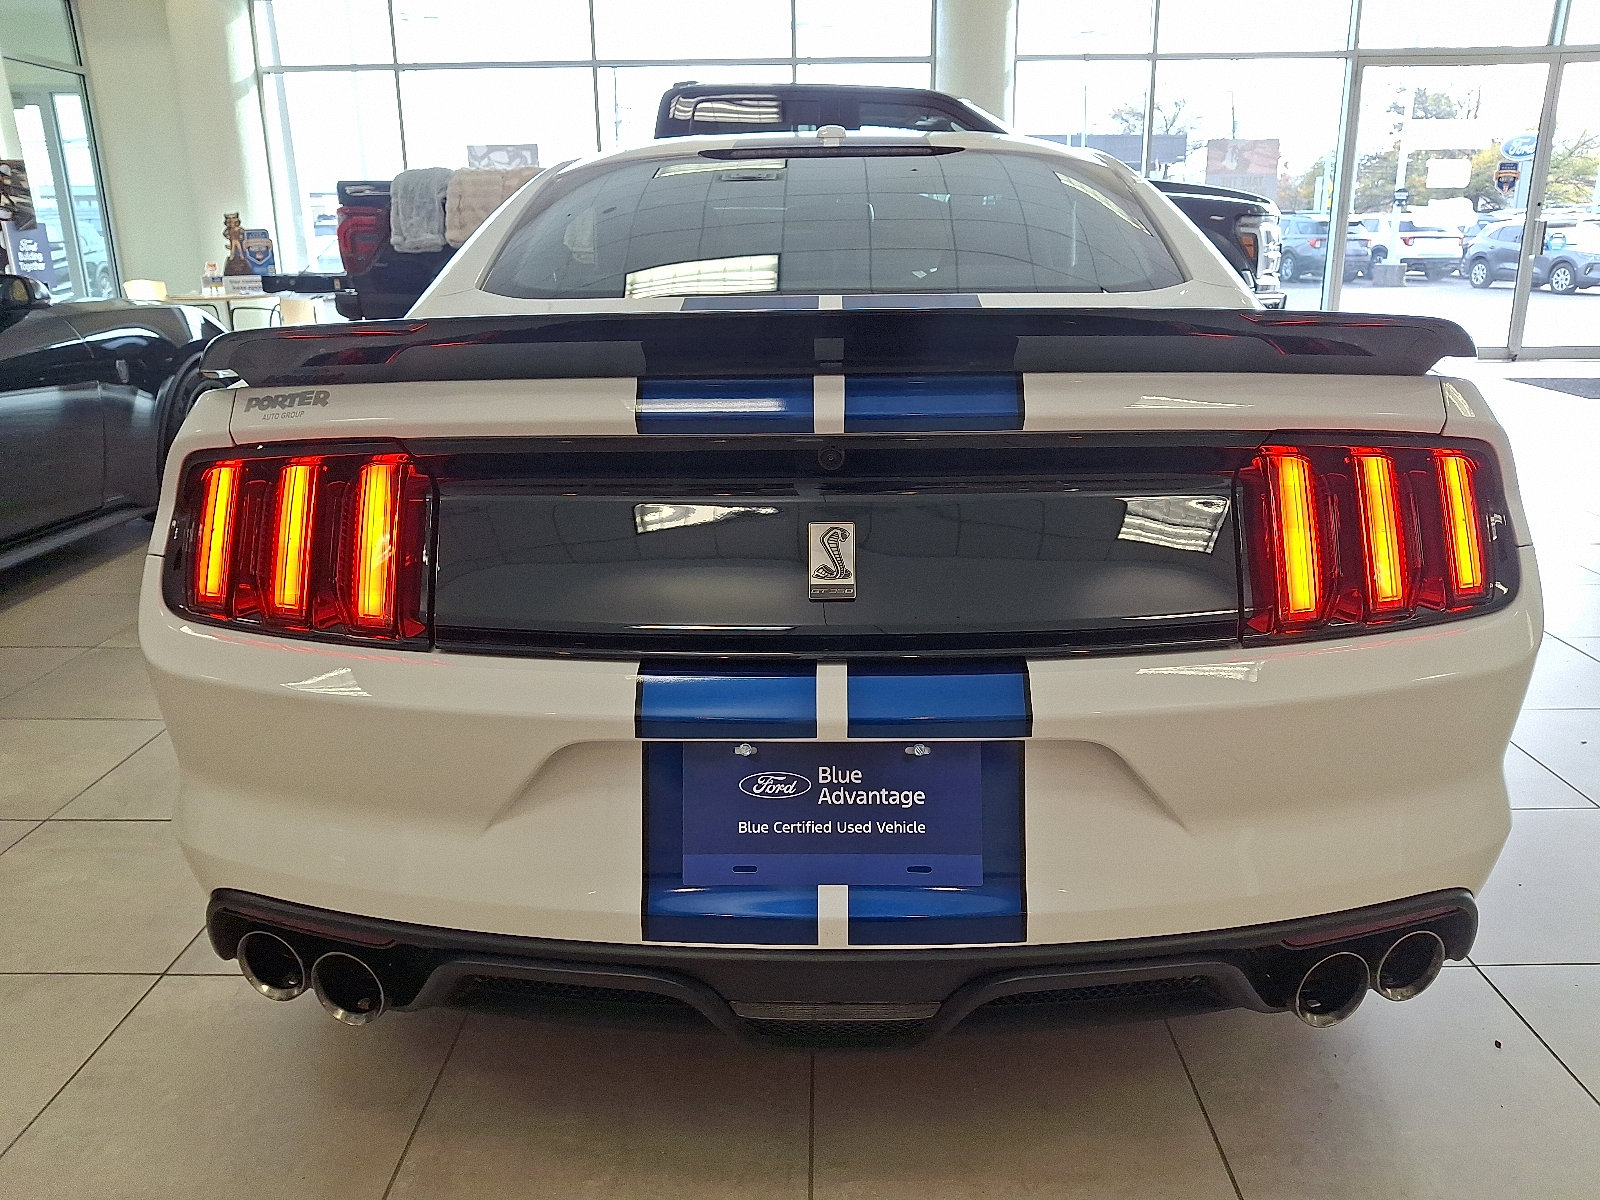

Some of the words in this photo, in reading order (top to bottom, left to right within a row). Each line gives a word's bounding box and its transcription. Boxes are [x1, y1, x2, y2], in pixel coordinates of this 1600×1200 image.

[1509, 138, 1535, 155] Ford
[17, 251, 44, 263] Building
[18, 261, 46, 273] Together
[244, 390, 330, 412] PORTER
[262, 412, 280, 420] AUTO
[281, 411, 304, 419] GROUP
[818, 766, 862, 784] Blue
[753, 775, 797, 795] Ford
[818, 787, 926, 808] Advantage
[738, 821, 769, 834] Blue
[773, 821, 832, 834] Certified
[837, 821, 872, 834] Used
[876, 821, 926, 834] Vehicle
